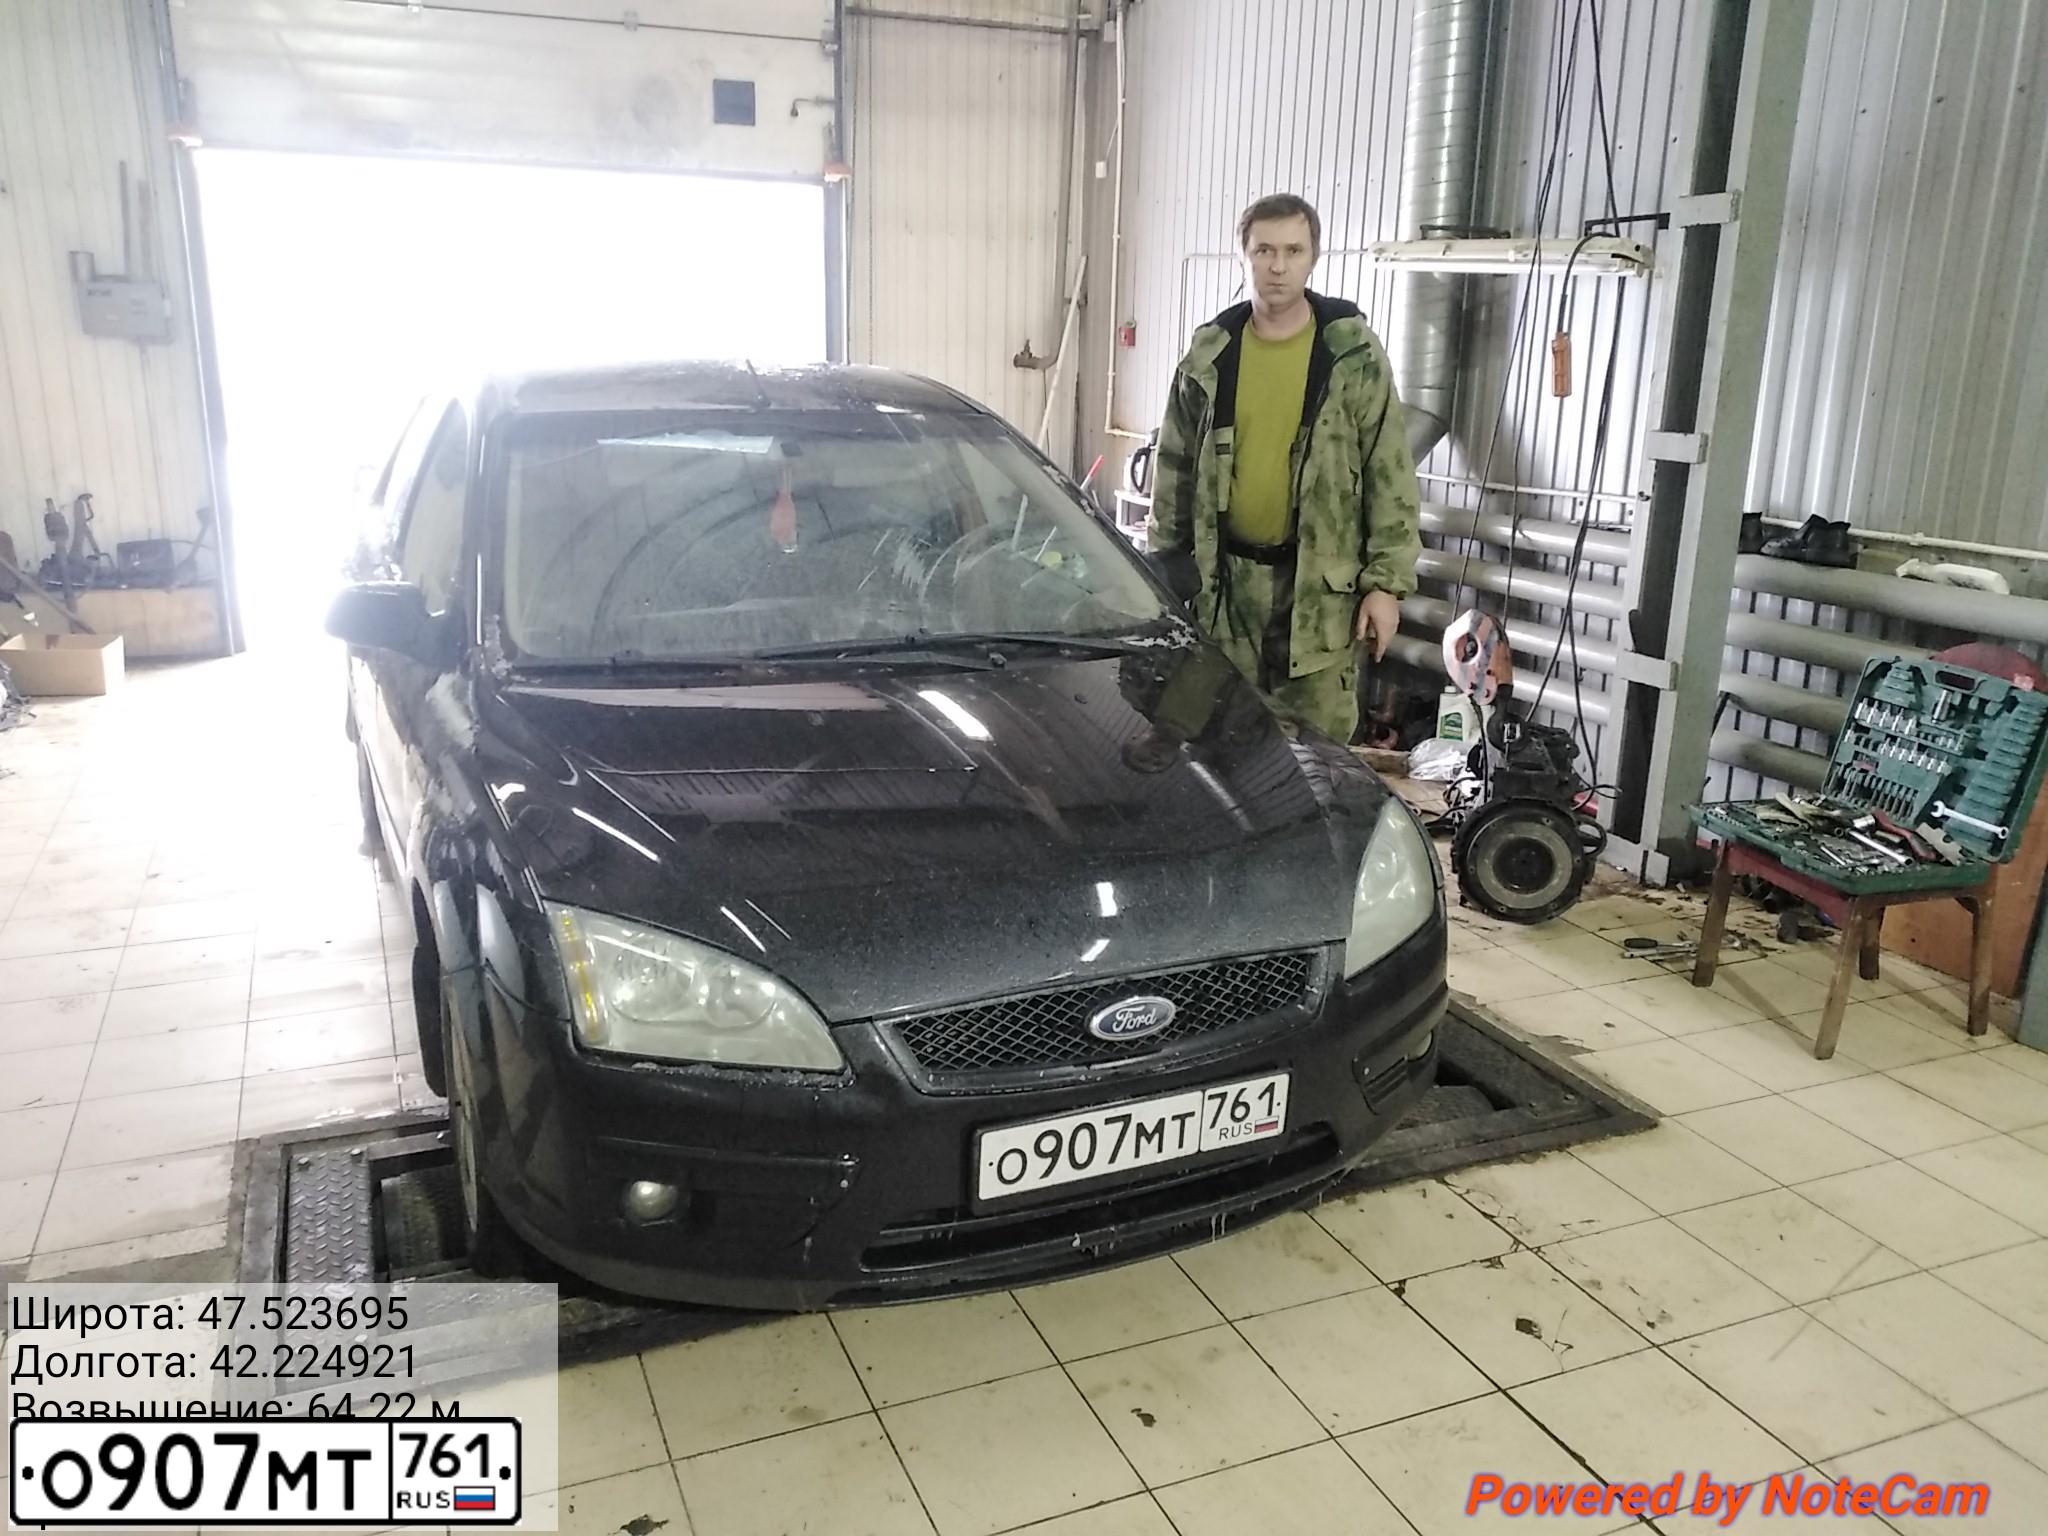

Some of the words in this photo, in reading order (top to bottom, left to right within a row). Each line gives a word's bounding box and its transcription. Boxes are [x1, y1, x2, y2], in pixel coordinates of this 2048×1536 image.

[1111, 1005, 1157, 1033] Ford
[1206, 1081, 1277, 1131] 761
[1218, 1121, 1254, 1141] RUS
